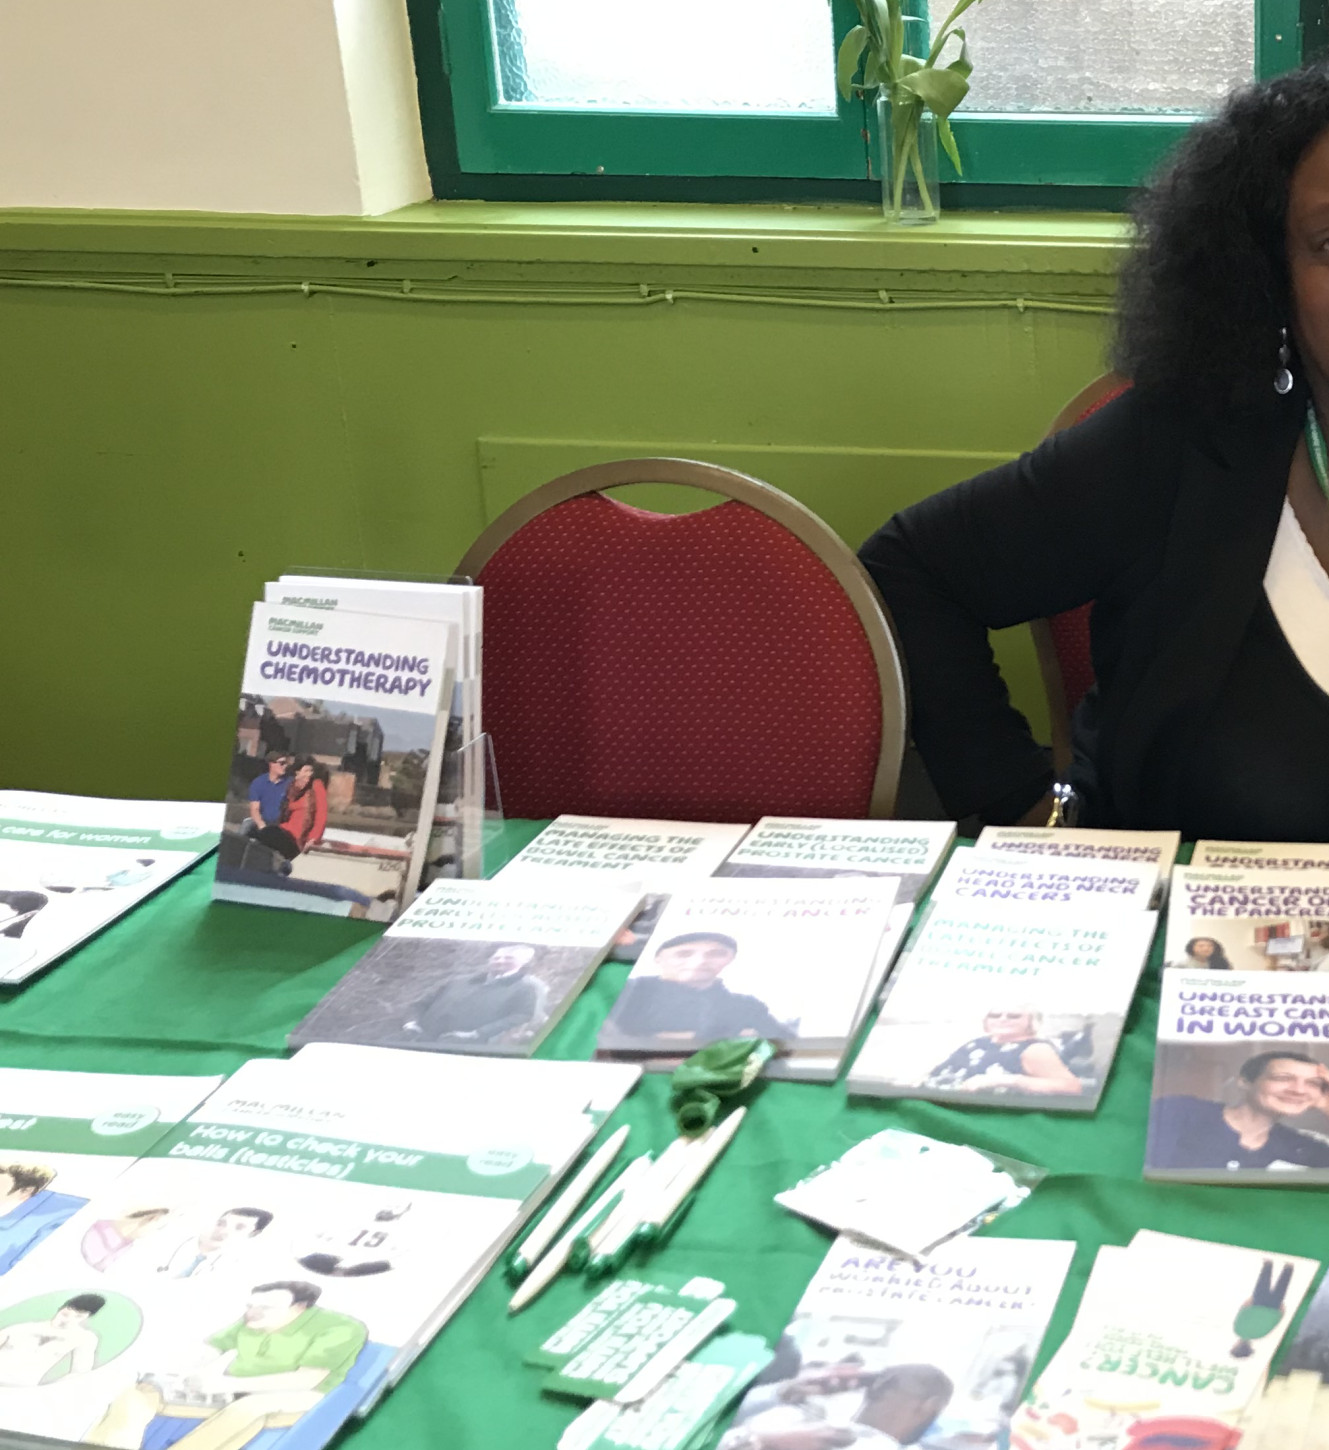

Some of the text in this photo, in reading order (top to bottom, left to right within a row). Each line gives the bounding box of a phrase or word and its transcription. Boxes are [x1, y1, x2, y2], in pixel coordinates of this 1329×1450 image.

[267, 640, 432, 675] UNDERSTANDING
[260, 661, 433, 697] CHEMOTHERAPY
[2, 826, 152, 844] care for women
[544, 829, 706, 846] MANAGING THE
[757, 830, 931, 846] UNDERSTANDING
[536, 838, 699, 854] LATE EFFECTS OF
[749, 840, 929, 856] EARLY (LOCALISED)
[990, 841, 1163, 855] UNDERSTANDING
[526, 846, 688, 864] BOWEL CANCER
[737, 848, 927, 865] PROSTATE CANCER
[962, 867, 1141, 886] UNDERSTANDING
[955, 887, 1072, 901] CANCERS
[957, 876, 1138, 895] HEAD AND NECK
[1189, 894, 1301, 907] CANCER
[1187, 905, 1229, 917] THE
[1072, 929, 1110, 940] THE
[1078, 943, 1105, 953] OF
[1180, 1003, 1279, 1019] BREAST
[1176, 1017, 1214, 1035] IN
[190, 1124, 425, 1167] How to check your
[169, 1141, 356, 1180] balls (testicles)
[840, 1256, 977, 1278] ARE YOU
[1080, 1352, 1236, 1396] CANCER?
